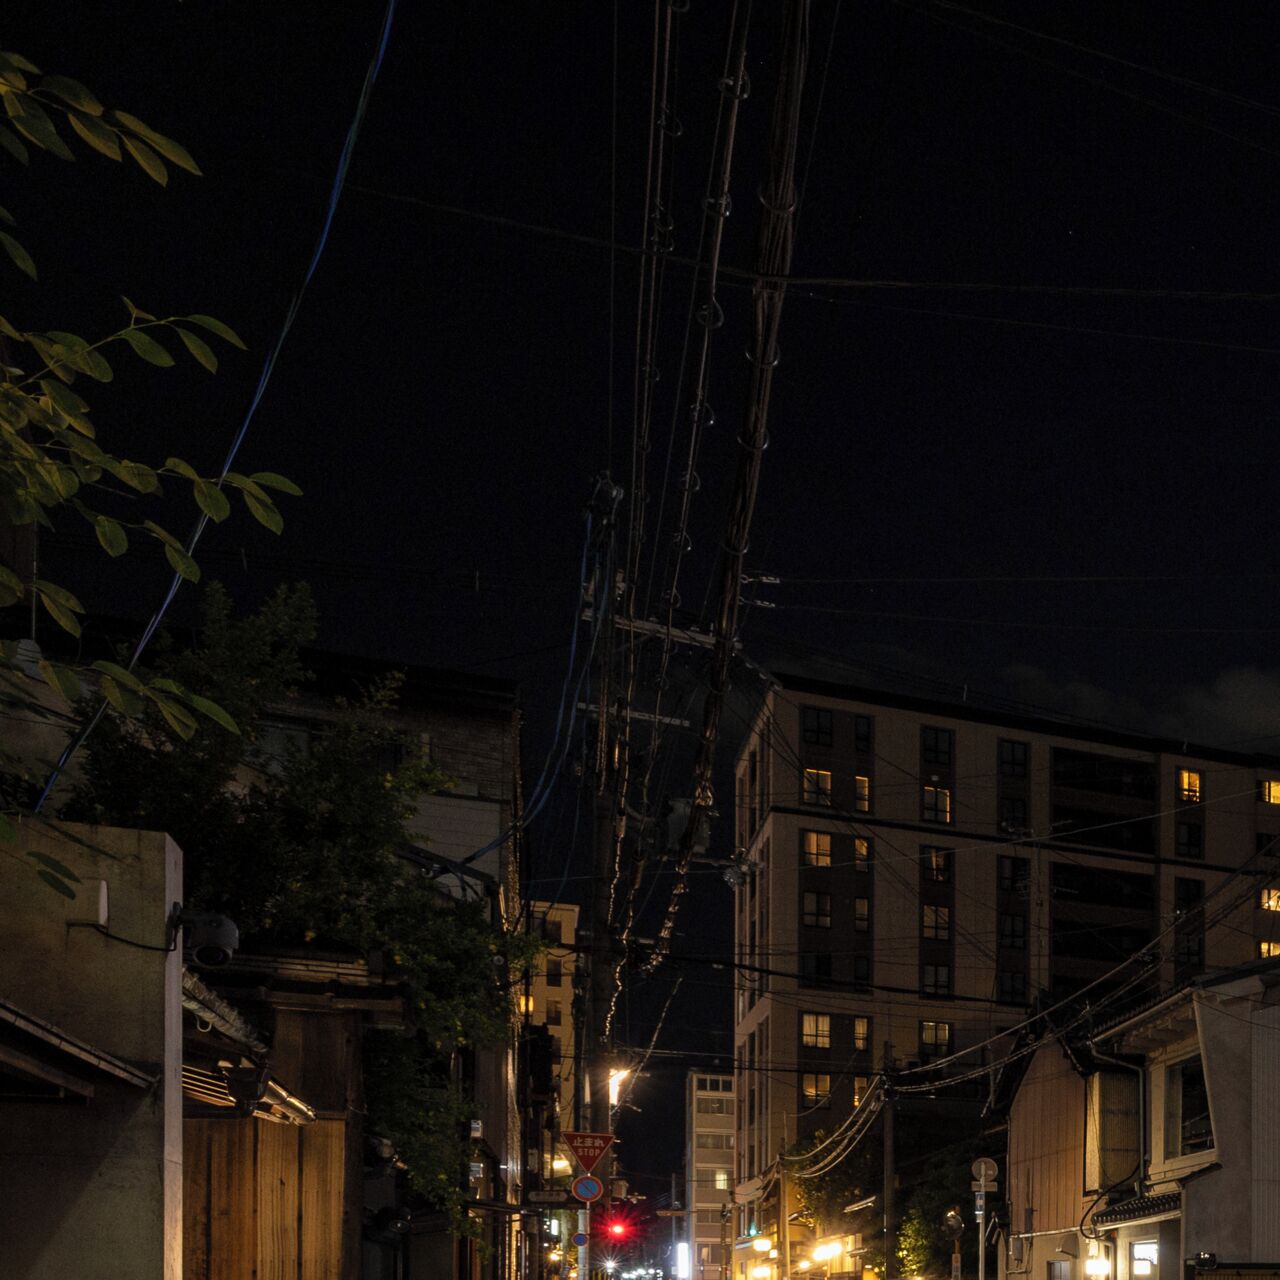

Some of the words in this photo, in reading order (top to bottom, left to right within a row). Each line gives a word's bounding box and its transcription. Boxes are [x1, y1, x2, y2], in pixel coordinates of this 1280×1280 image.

[572, 1136, 605, 1148] 止まれ
[577, 1148, 601, 1157] STOP
